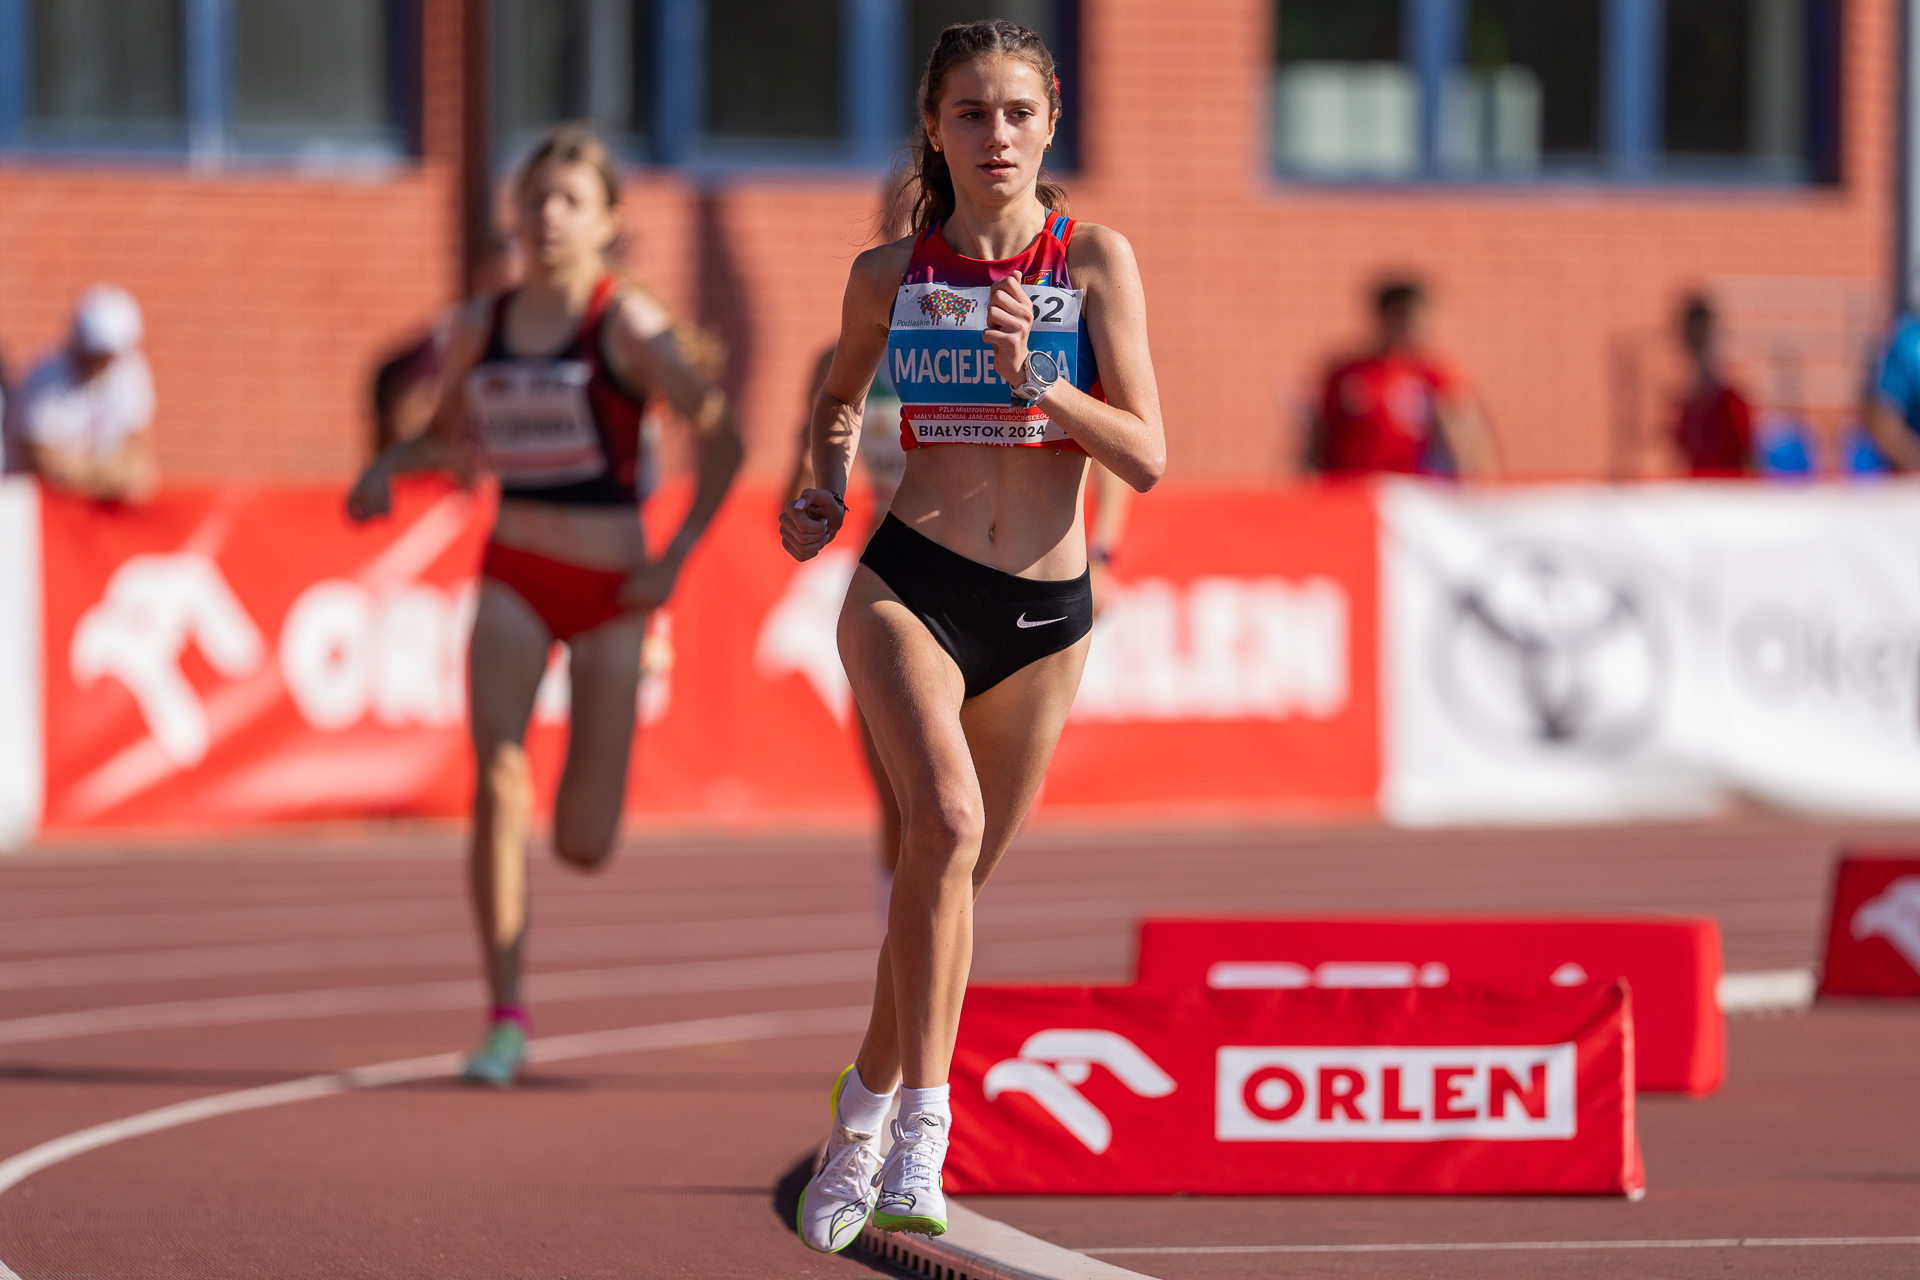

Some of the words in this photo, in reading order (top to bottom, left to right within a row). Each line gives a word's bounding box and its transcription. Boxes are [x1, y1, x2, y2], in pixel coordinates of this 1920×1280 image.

[896, 318, 931, 327] Podlaskie
[895, 348, 1071, 385] MACIEJEA
[955, 406, 995, 414] Mistrzostwa
[968, 413, 998, 421] JANUSZA
[918, 425, 1005, 438] BIAŁYSTOK
[1008, 424, 1046, 438] 2024
[1240, 1063, 1548, 1122] ORLEN
